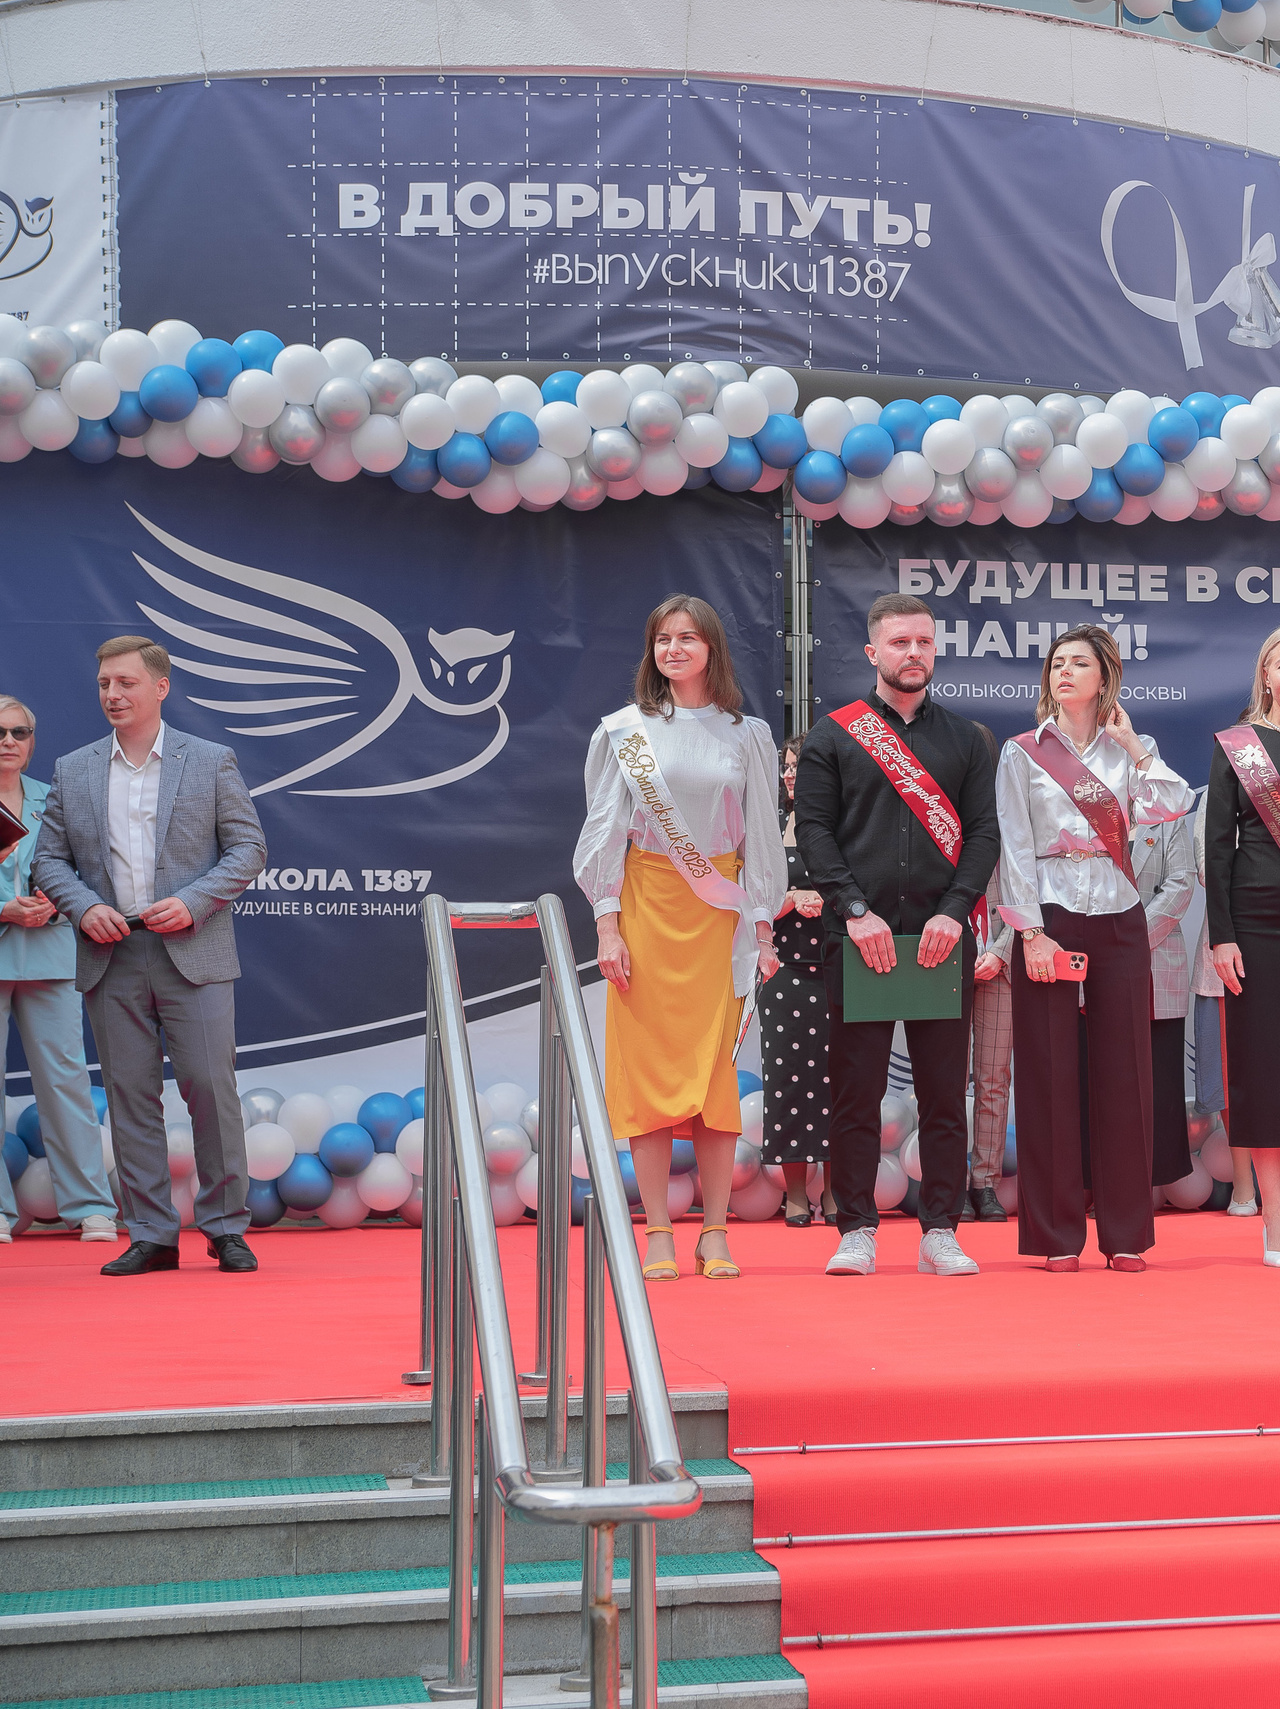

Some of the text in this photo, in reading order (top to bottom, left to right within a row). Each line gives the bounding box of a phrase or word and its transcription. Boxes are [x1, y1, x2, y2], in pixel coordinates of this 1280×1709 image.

[339, 172, 932, 249] В ДОБРЫЙ ПУТЬ!
[898, 557, 1169, 607] БУДУЩЕЕ
[1185, 565, 1220, 602] В
[674, 842, 712, 879] 2023
[361, 869, 432, 892] 1387
[231, 901, 421, 917] УДУЩЕЕ В СИЛЕ ЗНАНИ
